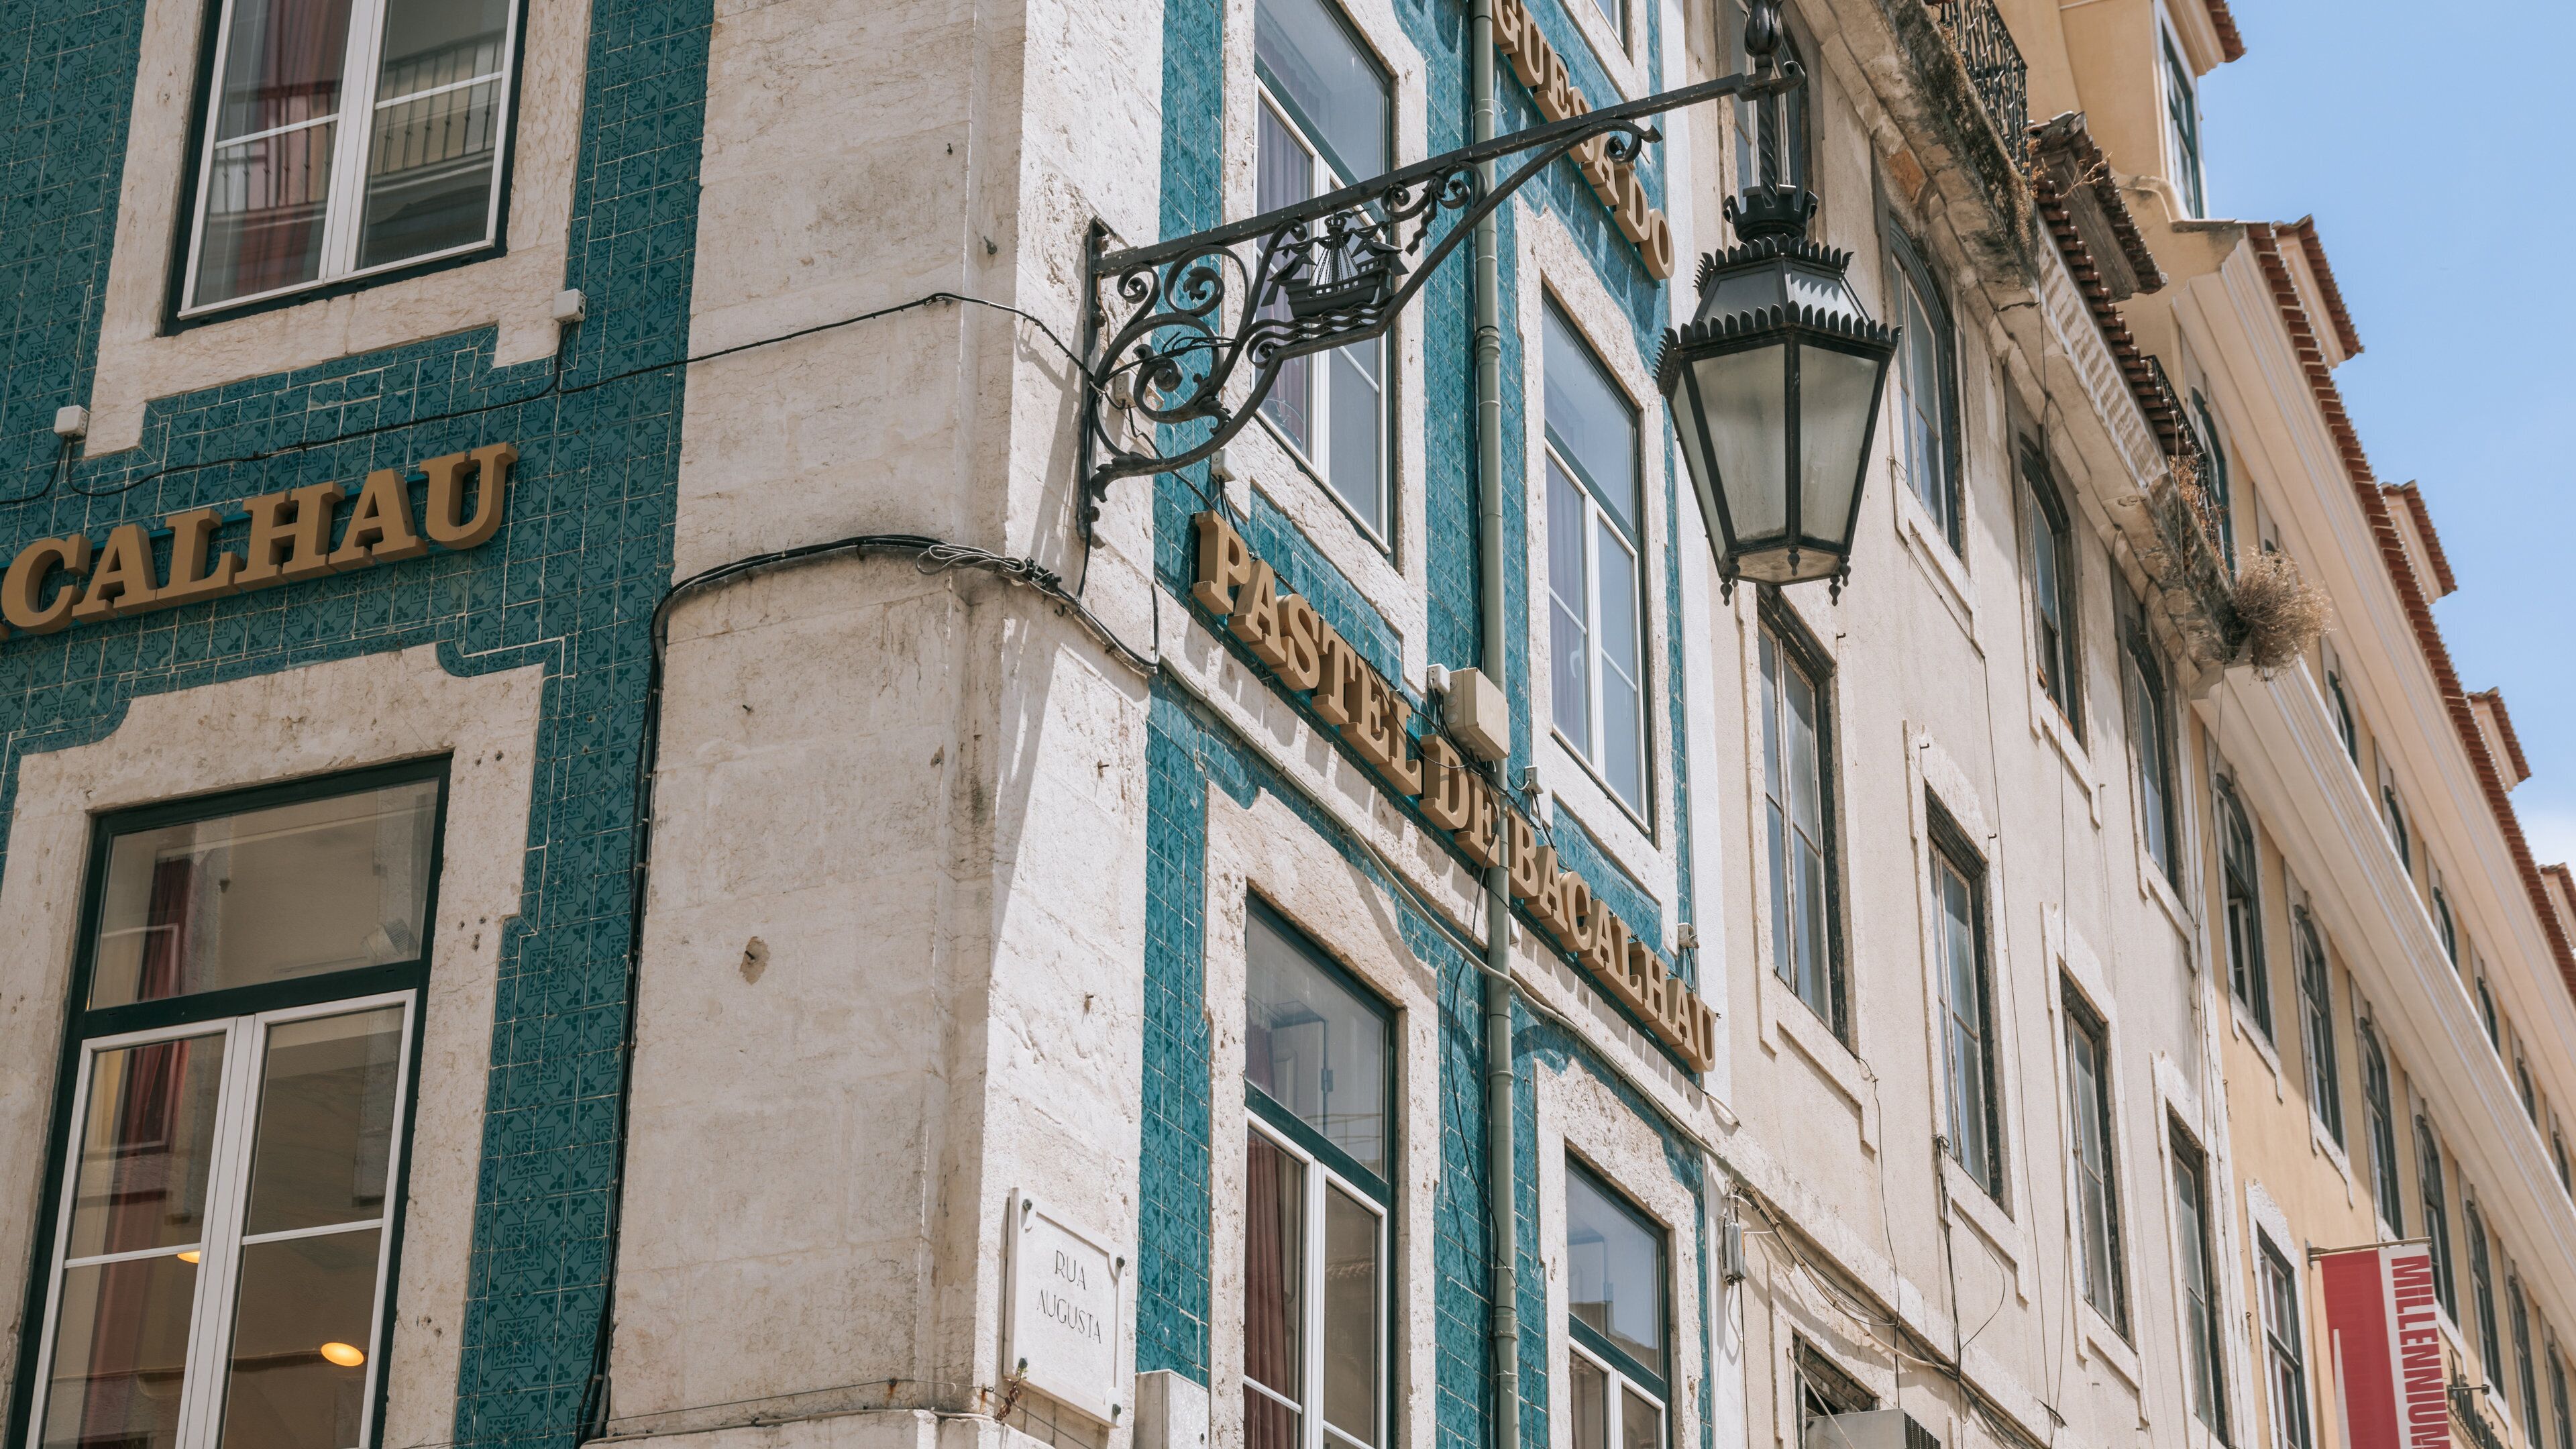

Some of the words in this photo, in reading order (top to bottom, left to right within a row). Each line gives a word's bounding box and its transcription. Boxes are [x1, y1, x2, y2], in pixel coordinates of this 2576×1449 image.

[0, 442, 519, 635] CALHAU
[1193, 509, 1422, 796] PASTEL
[1419, 734, 1500, 868] DE
[1507, 807, 1717, 1072] BACALHAU
[1036, 1289, 1102, 1344] AUGUSTA
[1054, 1249, 1087, 1291] RUA
[2390, 1254, 2453, 1449] MILLENNIUM
